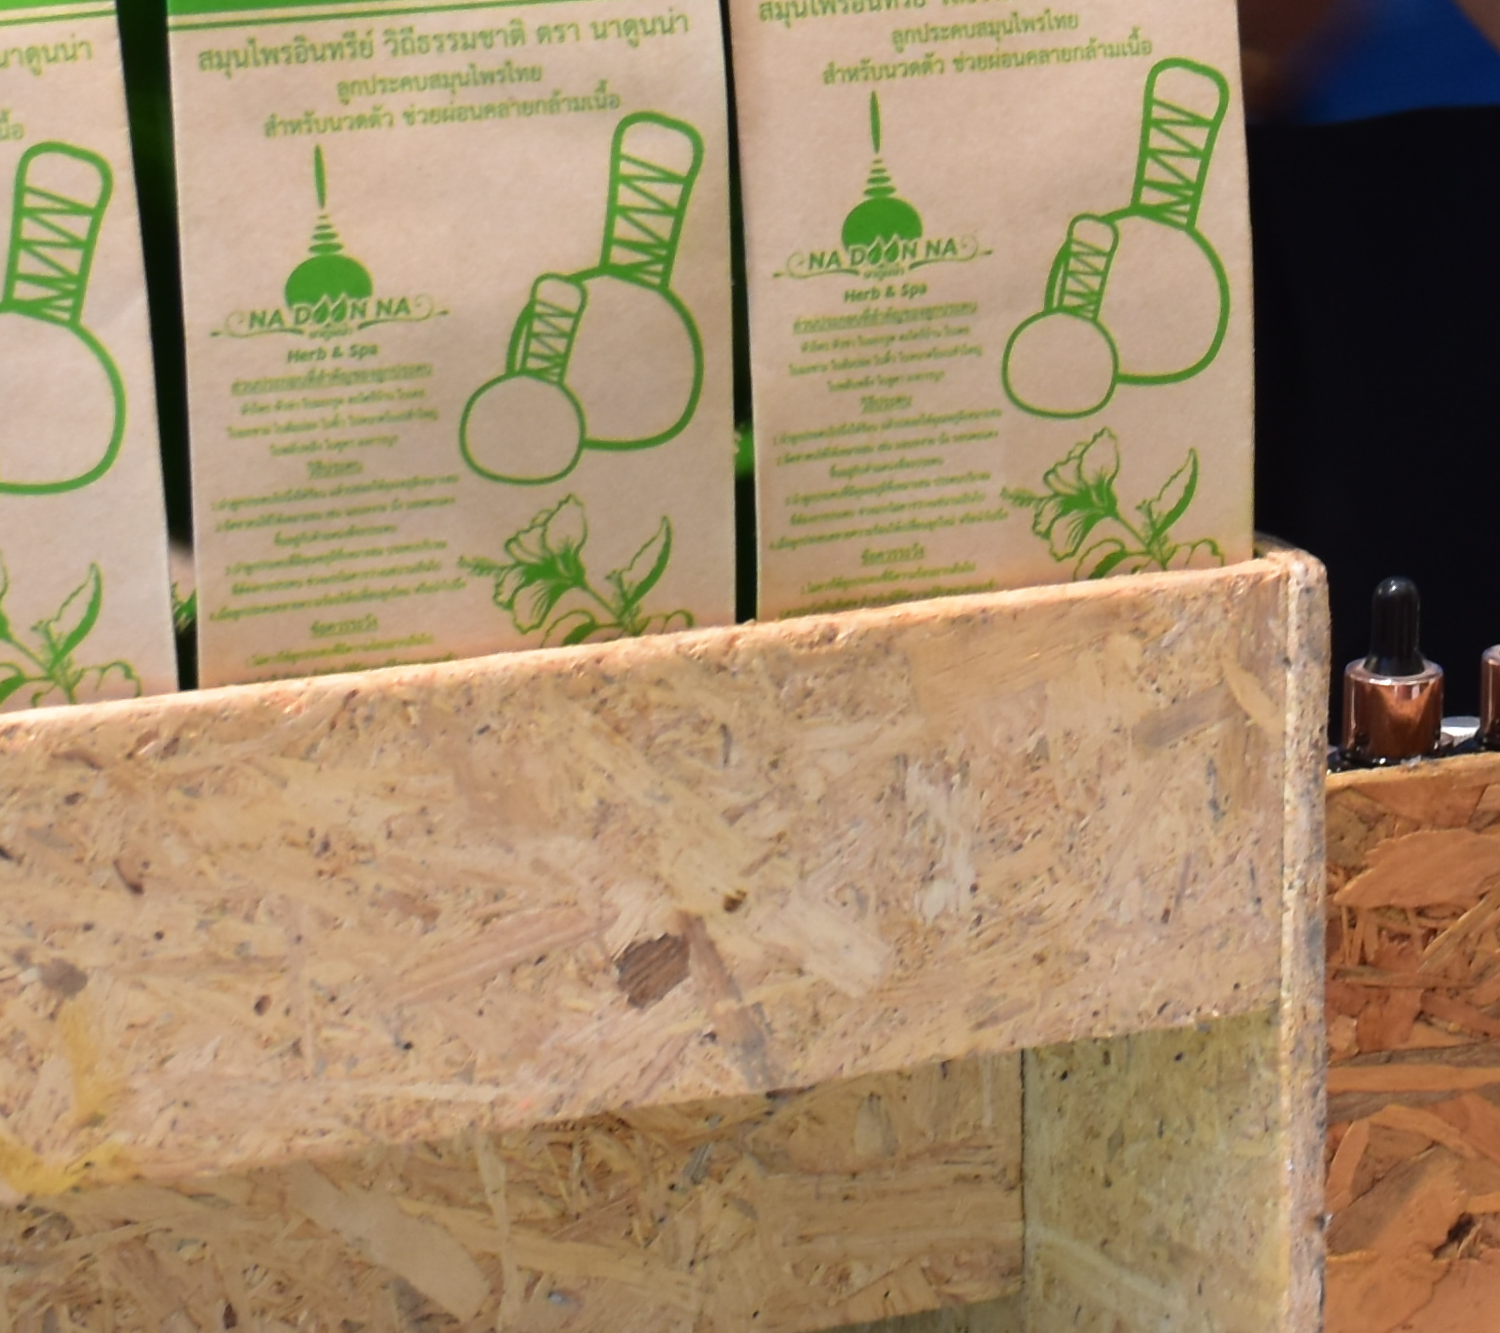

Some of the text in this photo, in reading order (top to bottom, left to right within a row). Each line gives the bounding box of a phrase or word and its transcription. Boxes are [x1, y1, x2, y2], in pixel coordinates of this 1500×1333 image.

[198, 29, 374, 79] สมุนไพรอินทรีย์
[537, 22, 580, 45] ตรา
[808, 251, 841, 270] NA
[926, 238, 958, 257] NA
[844, 283, 927, 302] Herb & Spa
[250, 309, 285, 329] NA
[377, 297, 411, 317] NA
[287, 344, 379, 364] Herb & Spa
